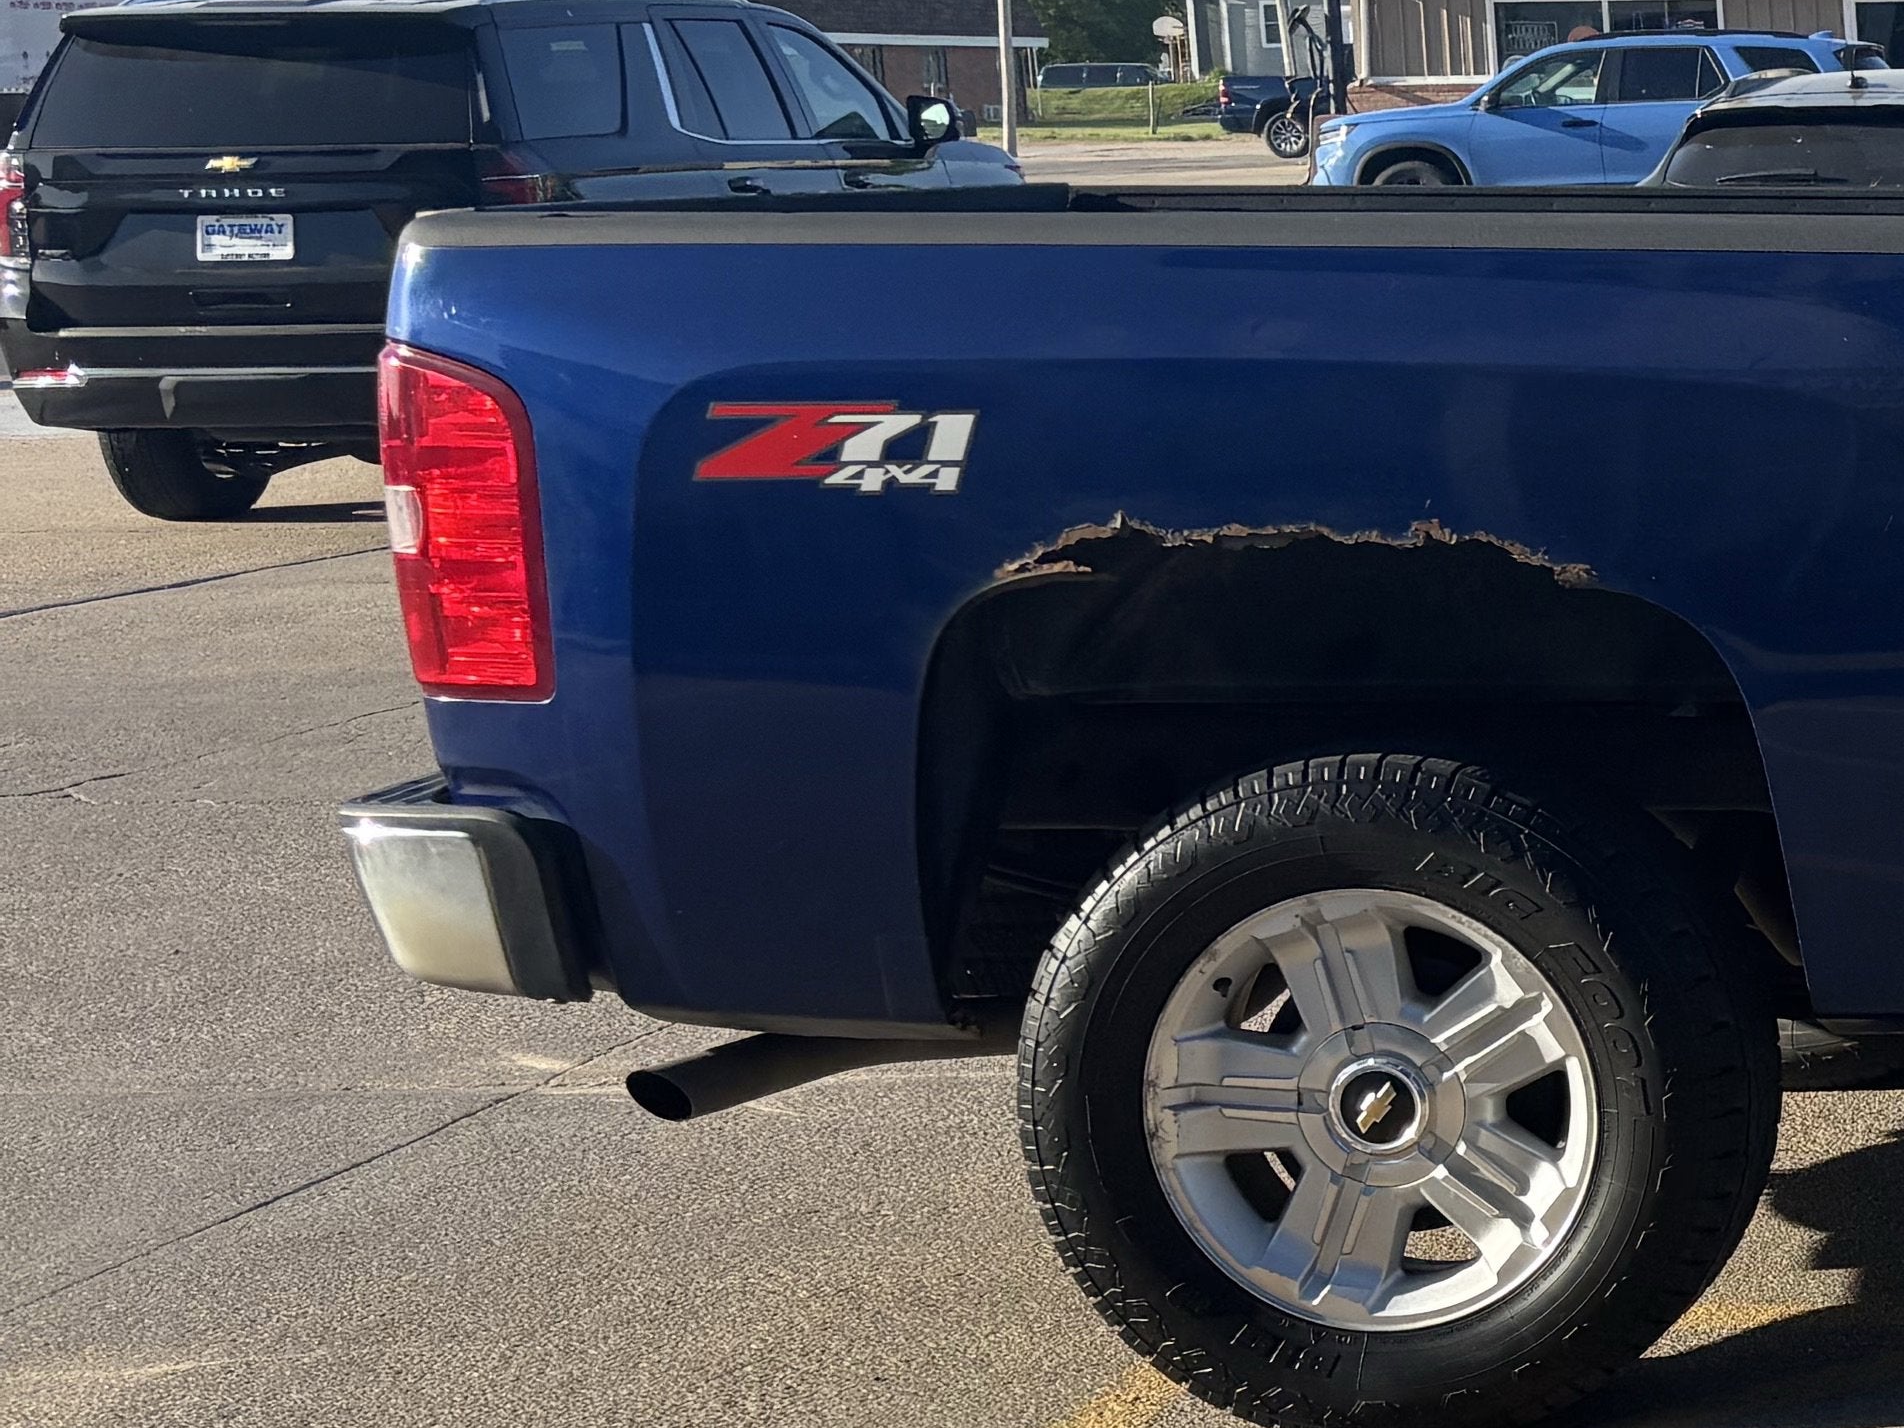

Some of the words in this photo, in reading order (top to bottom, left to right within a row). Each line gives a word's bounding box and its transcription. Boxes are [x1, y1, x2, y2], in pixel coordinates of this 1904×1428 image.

[178, 187, 286, 198] TAHOE
[205, 223, 284, 236] GATEWAY
[694, 401, 979, 480] Z71
